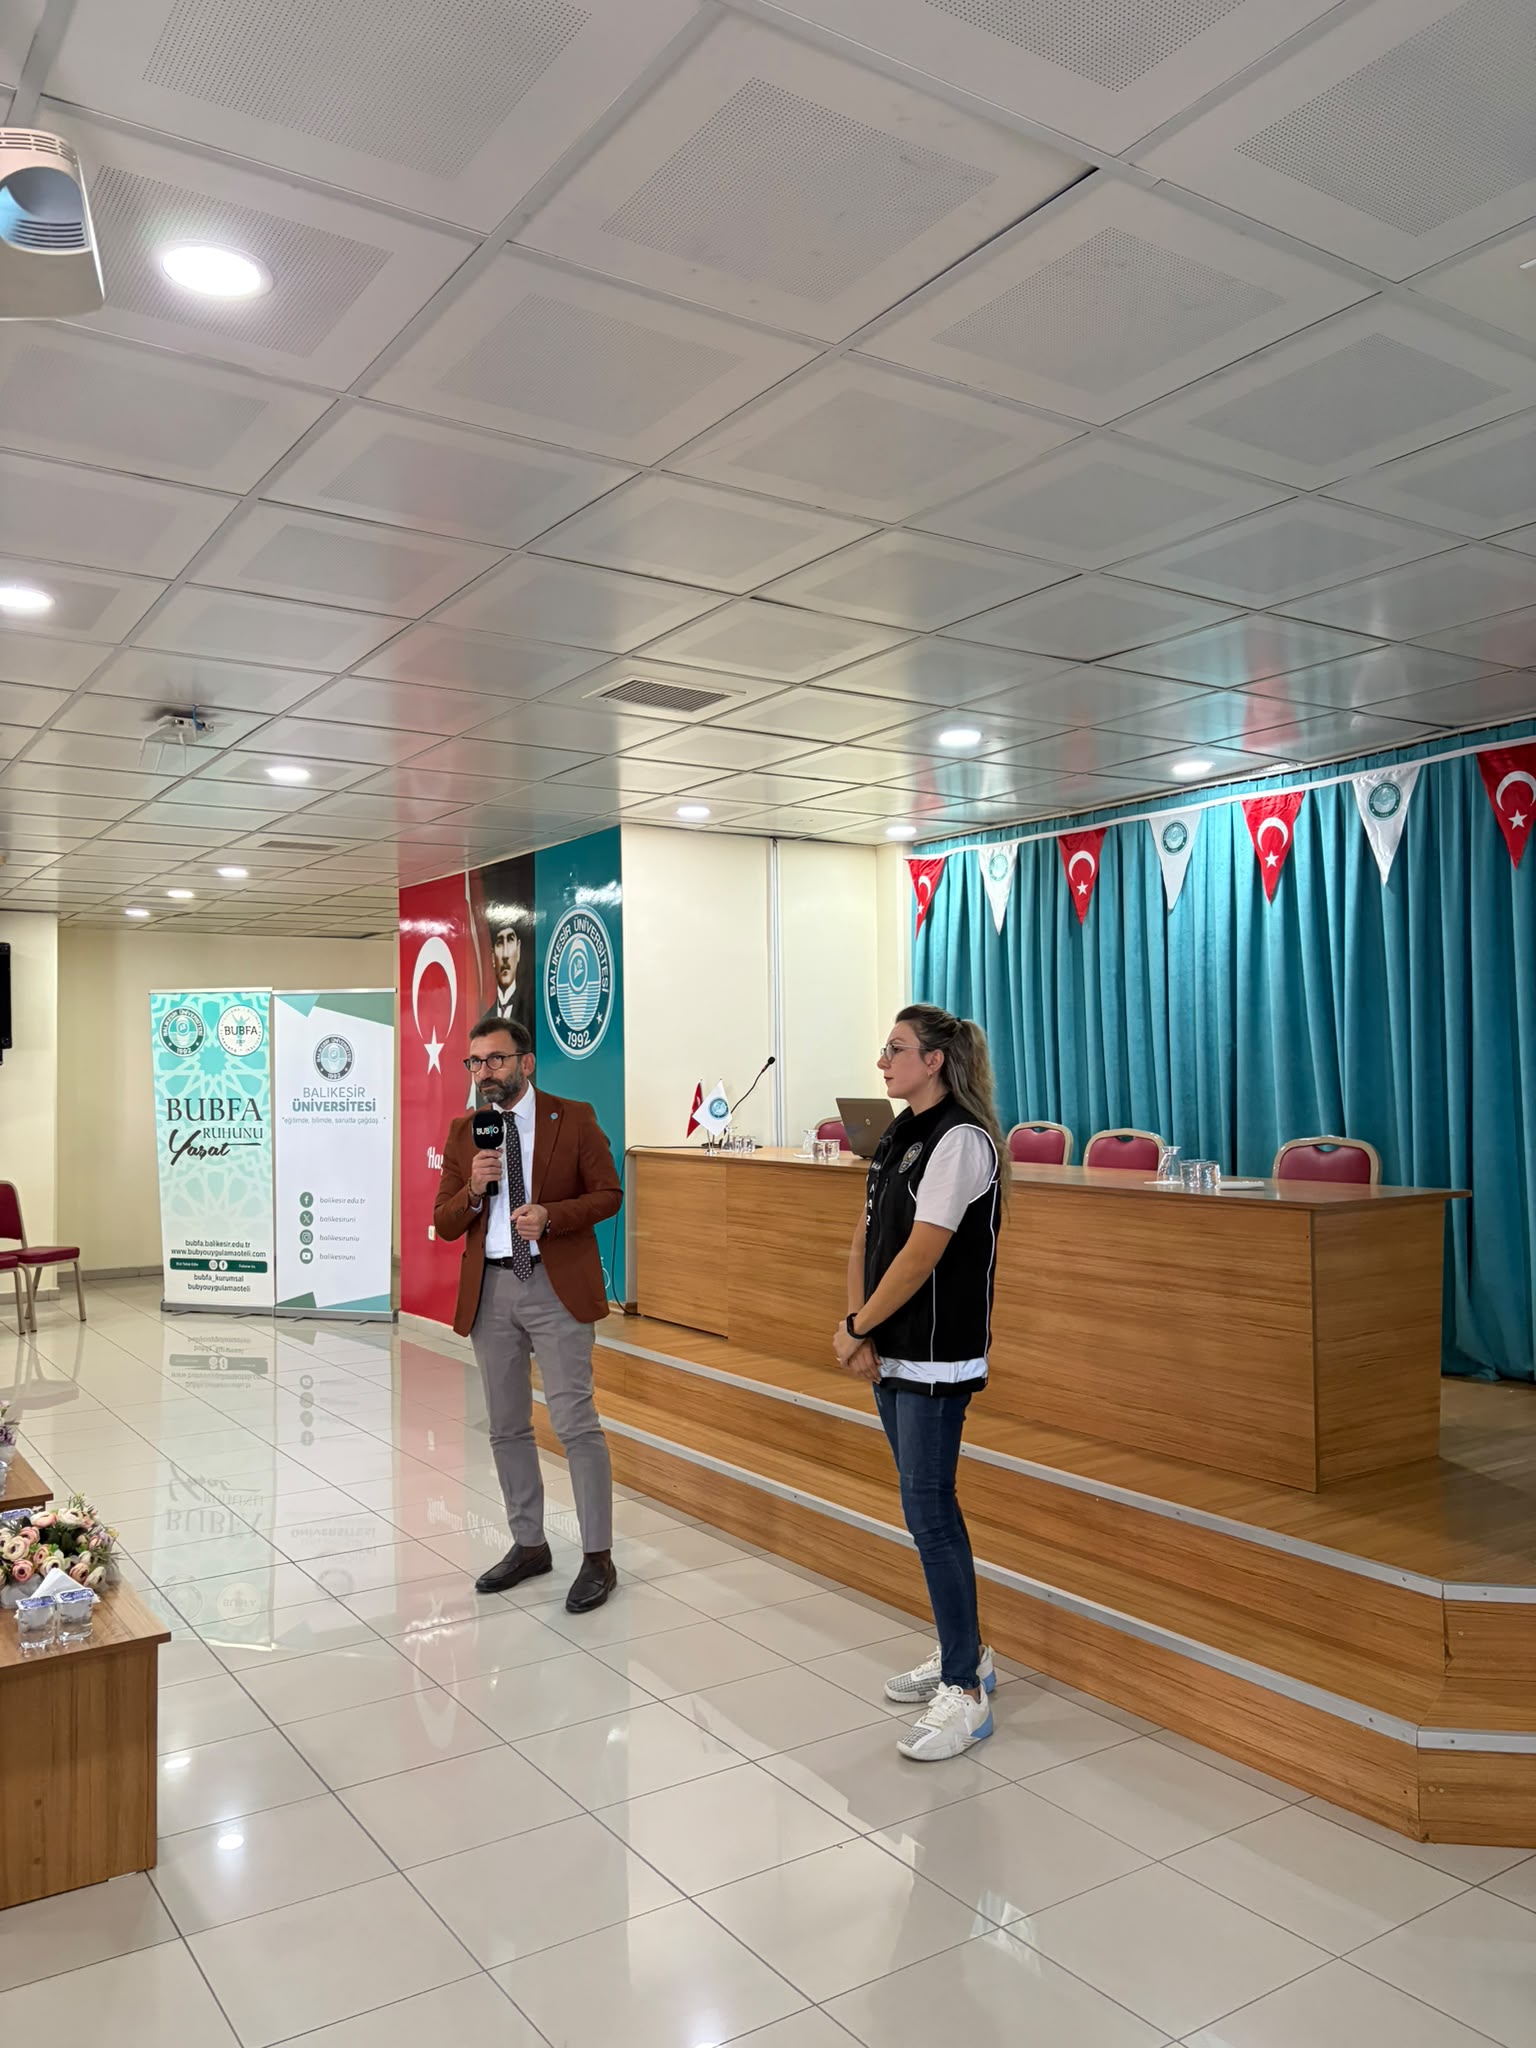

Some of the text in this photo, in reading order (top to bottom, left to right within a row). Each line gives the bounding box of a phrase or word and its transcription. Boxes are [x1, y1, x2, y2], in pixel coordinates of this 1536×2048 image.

[550, 916, 610, 997] BALIKESİR ÜNİVERSİTESİ
[224, 1025, 258, 1035] BUBFA
[567, 1031, 591, 1047] 1992
[303, 1084, 366, 1098] BALIKESİR
[166, 1098, 264, 1122] BUBFA
[292, 1098, 376, 1112] ÜNİVERSİTESİ
[203, 1127, 264, 1139] RUHUNU
[168, 1129, 262, 1166] Yaşat
[185, 1240, 251, 1249] bubfa.balikesir.edu.tr
[171, 1249, 266, 1258] www.bubyouygulamaoteli.com
[193, 1273, 244, 1283] bubfa_kurumsal
[187, 1283, 251, 1293] bubyouygulamaoteli
